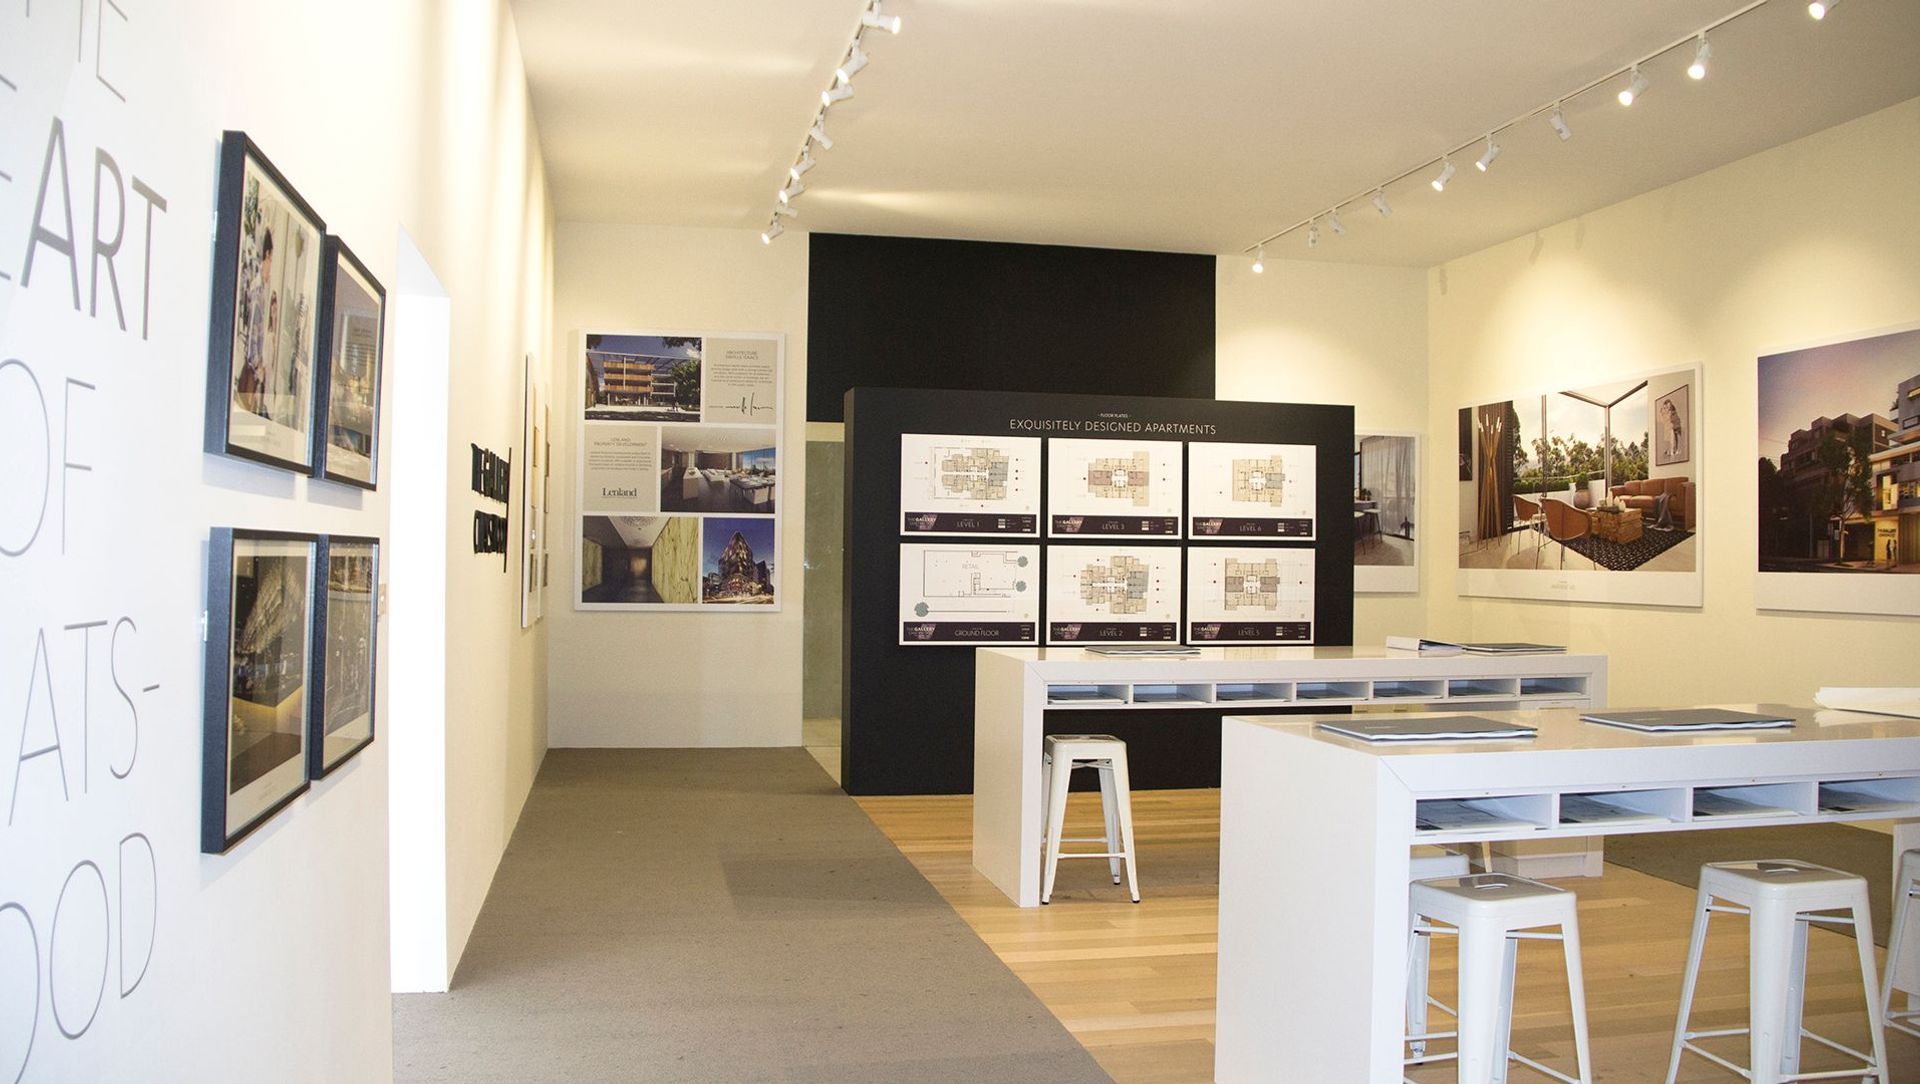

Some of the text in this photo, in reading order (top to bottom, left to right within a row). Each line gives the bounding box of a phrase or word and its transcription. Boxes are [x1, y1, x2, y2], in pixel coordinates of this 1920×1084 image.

[1009, 419, 1217, 435] EXQUISITELY DESIGNED APARTMENTS
[0, 358, 96, 557] OF
[602, 487, 637, 497] Lenland
